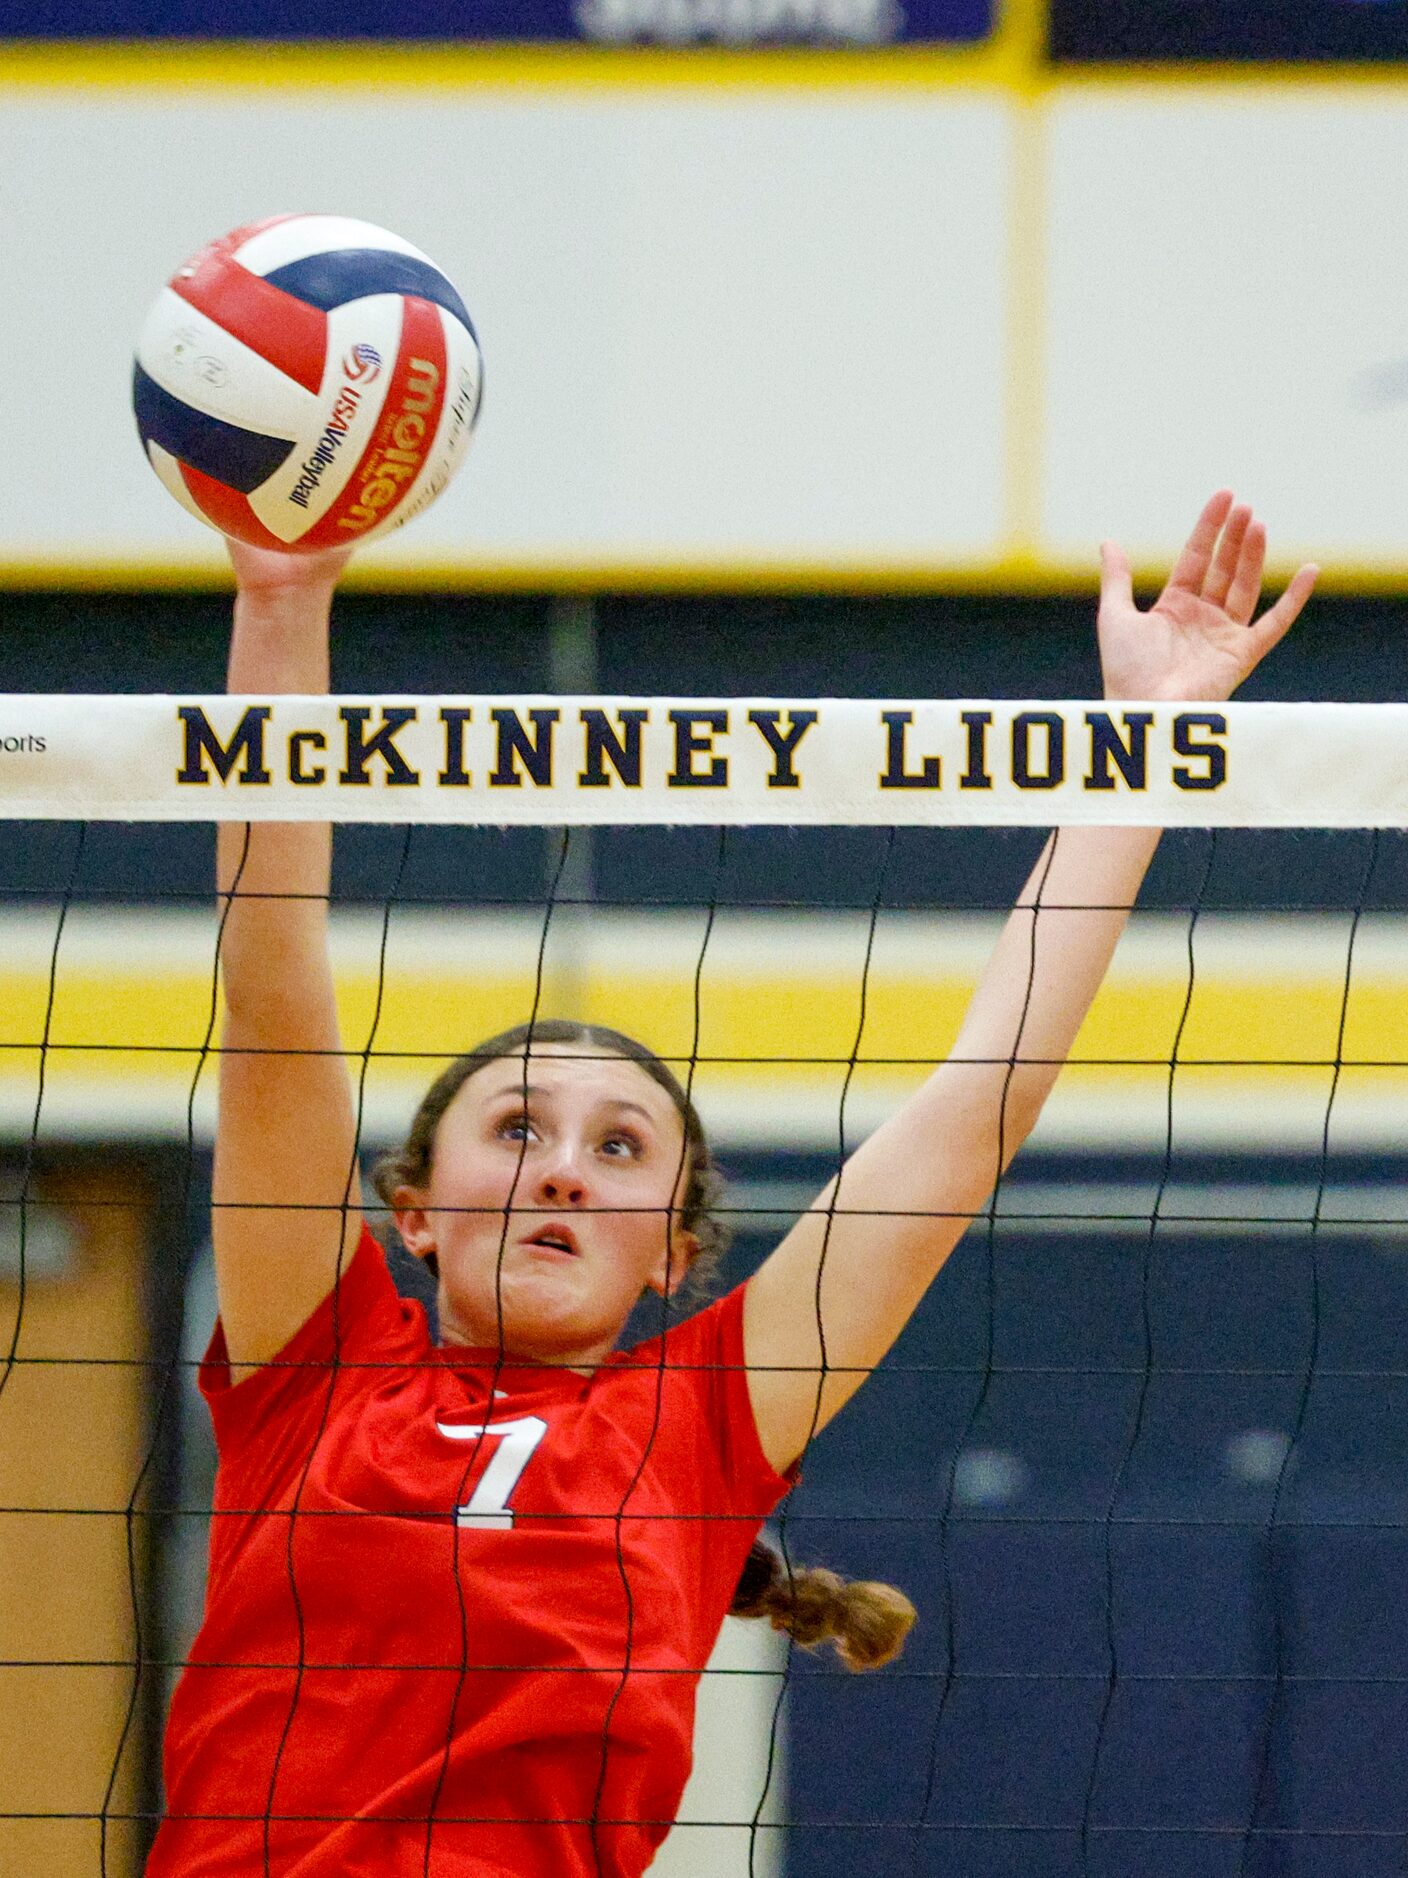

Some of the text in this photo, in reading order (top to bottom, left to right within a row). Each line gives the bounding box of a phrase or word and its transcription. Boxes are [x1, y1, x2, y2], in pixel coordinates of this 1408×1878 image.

[337, 357, 440, 529] molten
[0, 733, 47, 753] orts
[176, 705, 1229, 792] McKINNEY LIONS
[436, 1415, 548, 1530] 7
